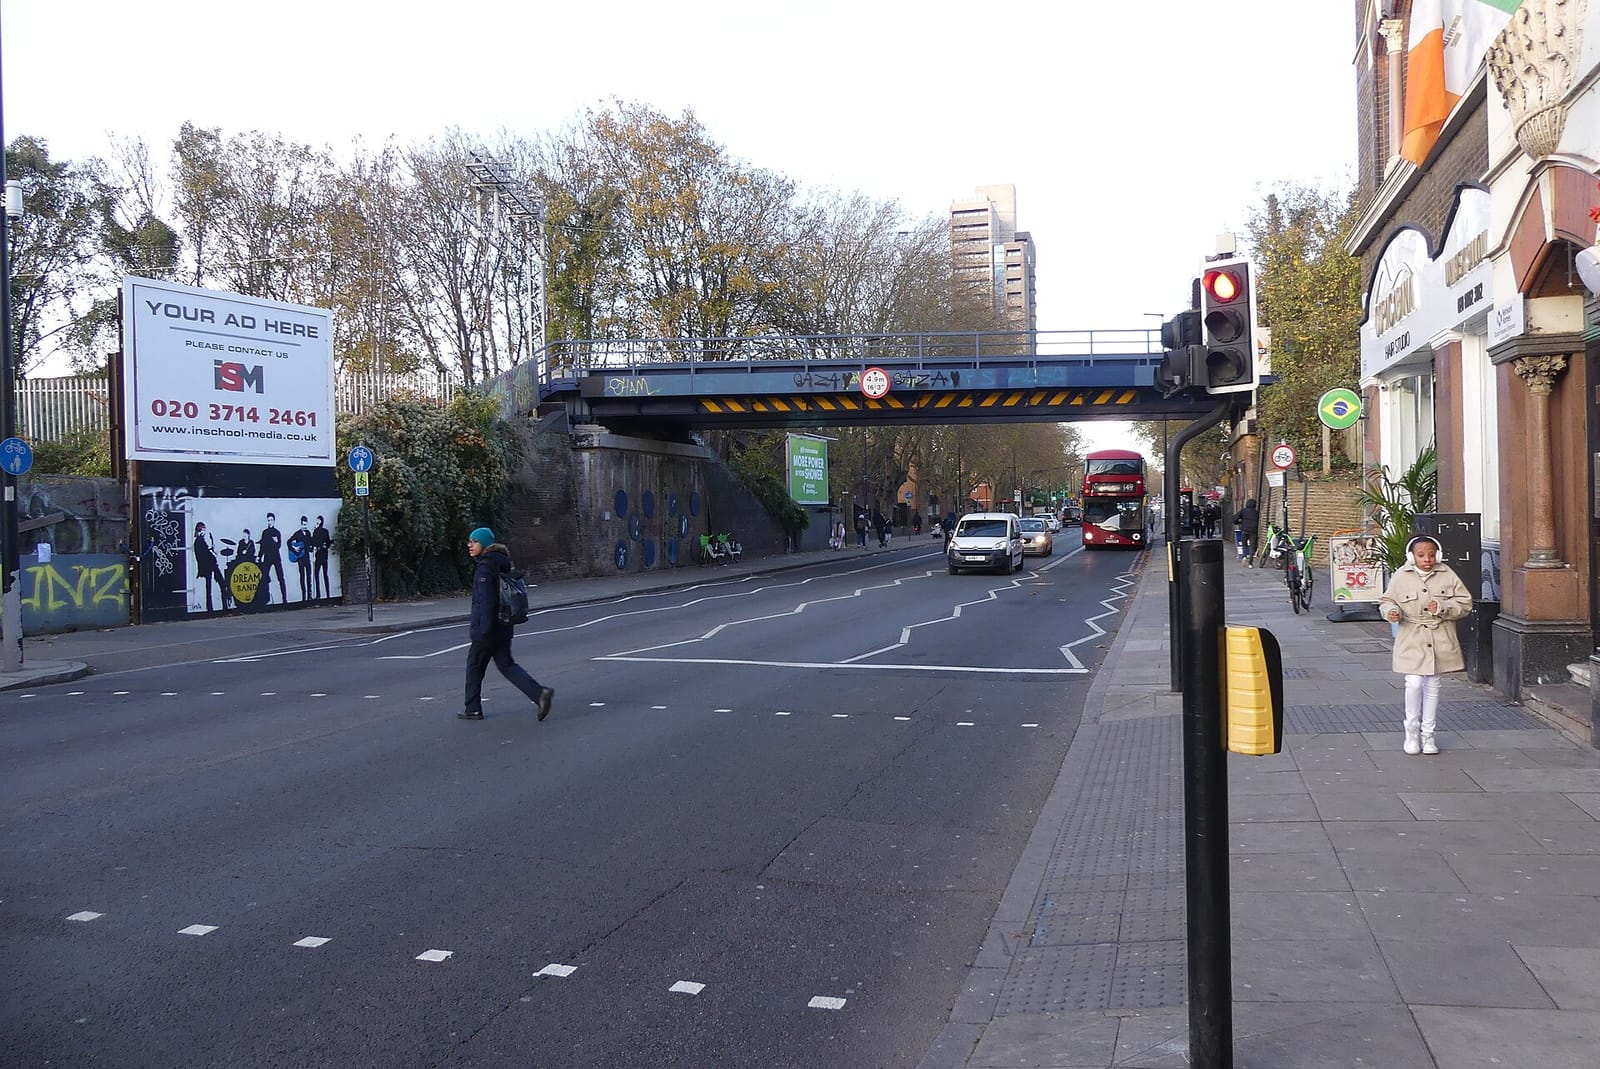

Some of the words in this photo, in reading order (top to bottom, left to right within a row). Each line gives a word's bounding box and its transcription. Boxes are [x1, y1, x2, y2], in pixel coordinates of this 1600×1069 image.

[146, 300, 215, 324] YOUR
[224, 313, 256, 330] AD
[264, 318, 319, 339] HERE
[185, 340, 225, 351] PLEASE
[228, 345, 273, 357] CONTACT
[276, 351, 289, 359] US
[151, 399, 199, 419] 020
[208, 403, 260, 423] 3714
[269, 408, 317, 427] 2461
[151, 425, 318, 442] www.inschool-media.co.uk
[793, 455, 808, 468] MORE
[808, 456, 825, 469] POWER
[804, 468, 824, 481] SHOWER
[233, 573, 260, 583] DREAM
[236, 584, 257, 592] BAND
